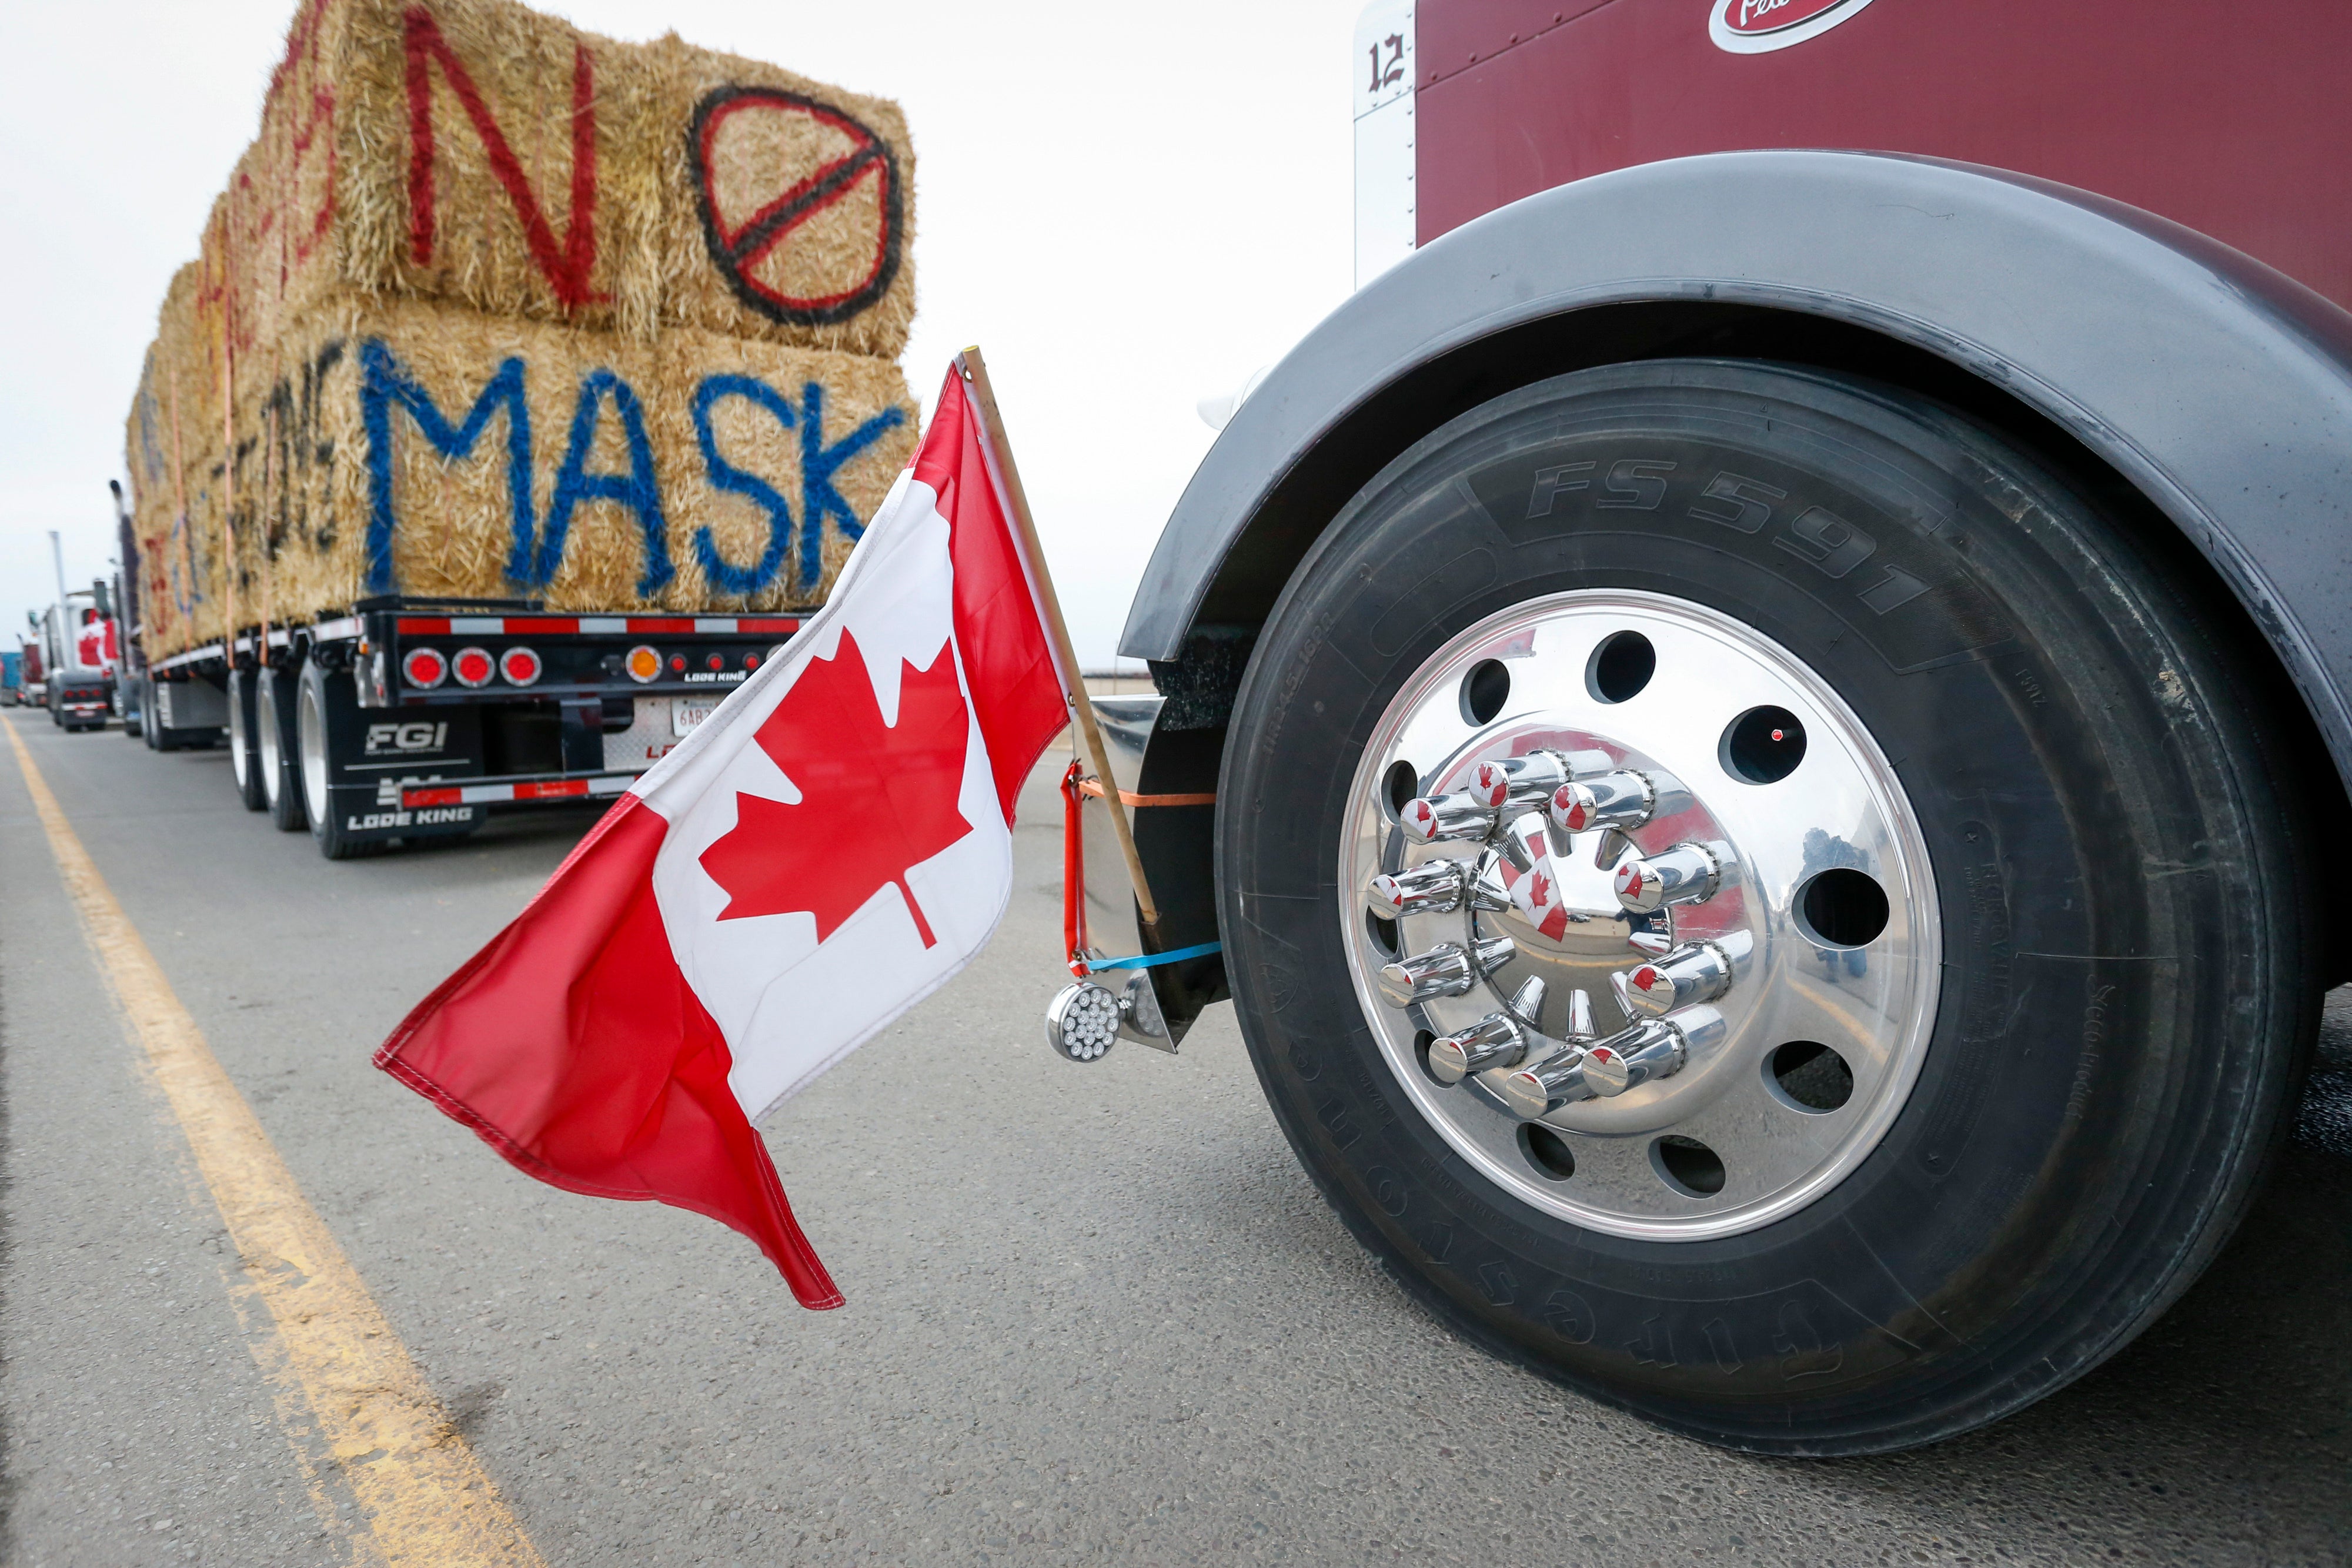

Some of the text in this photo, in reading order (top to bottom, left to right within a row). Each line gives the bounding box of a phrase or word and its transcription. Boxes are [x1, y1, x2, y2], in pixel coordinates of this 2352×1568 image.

[1369, 32, 1405, 93] 12
[403, 6, 904, 326] NO
[359, 337, 906, 599] MASK
[1526, 460, 1931, 616] FS 591
[684, 670, 747, 683] LODE KING
[365, 721, 449, 751] FGI
[348, 807, 473, 831] LODE KING
